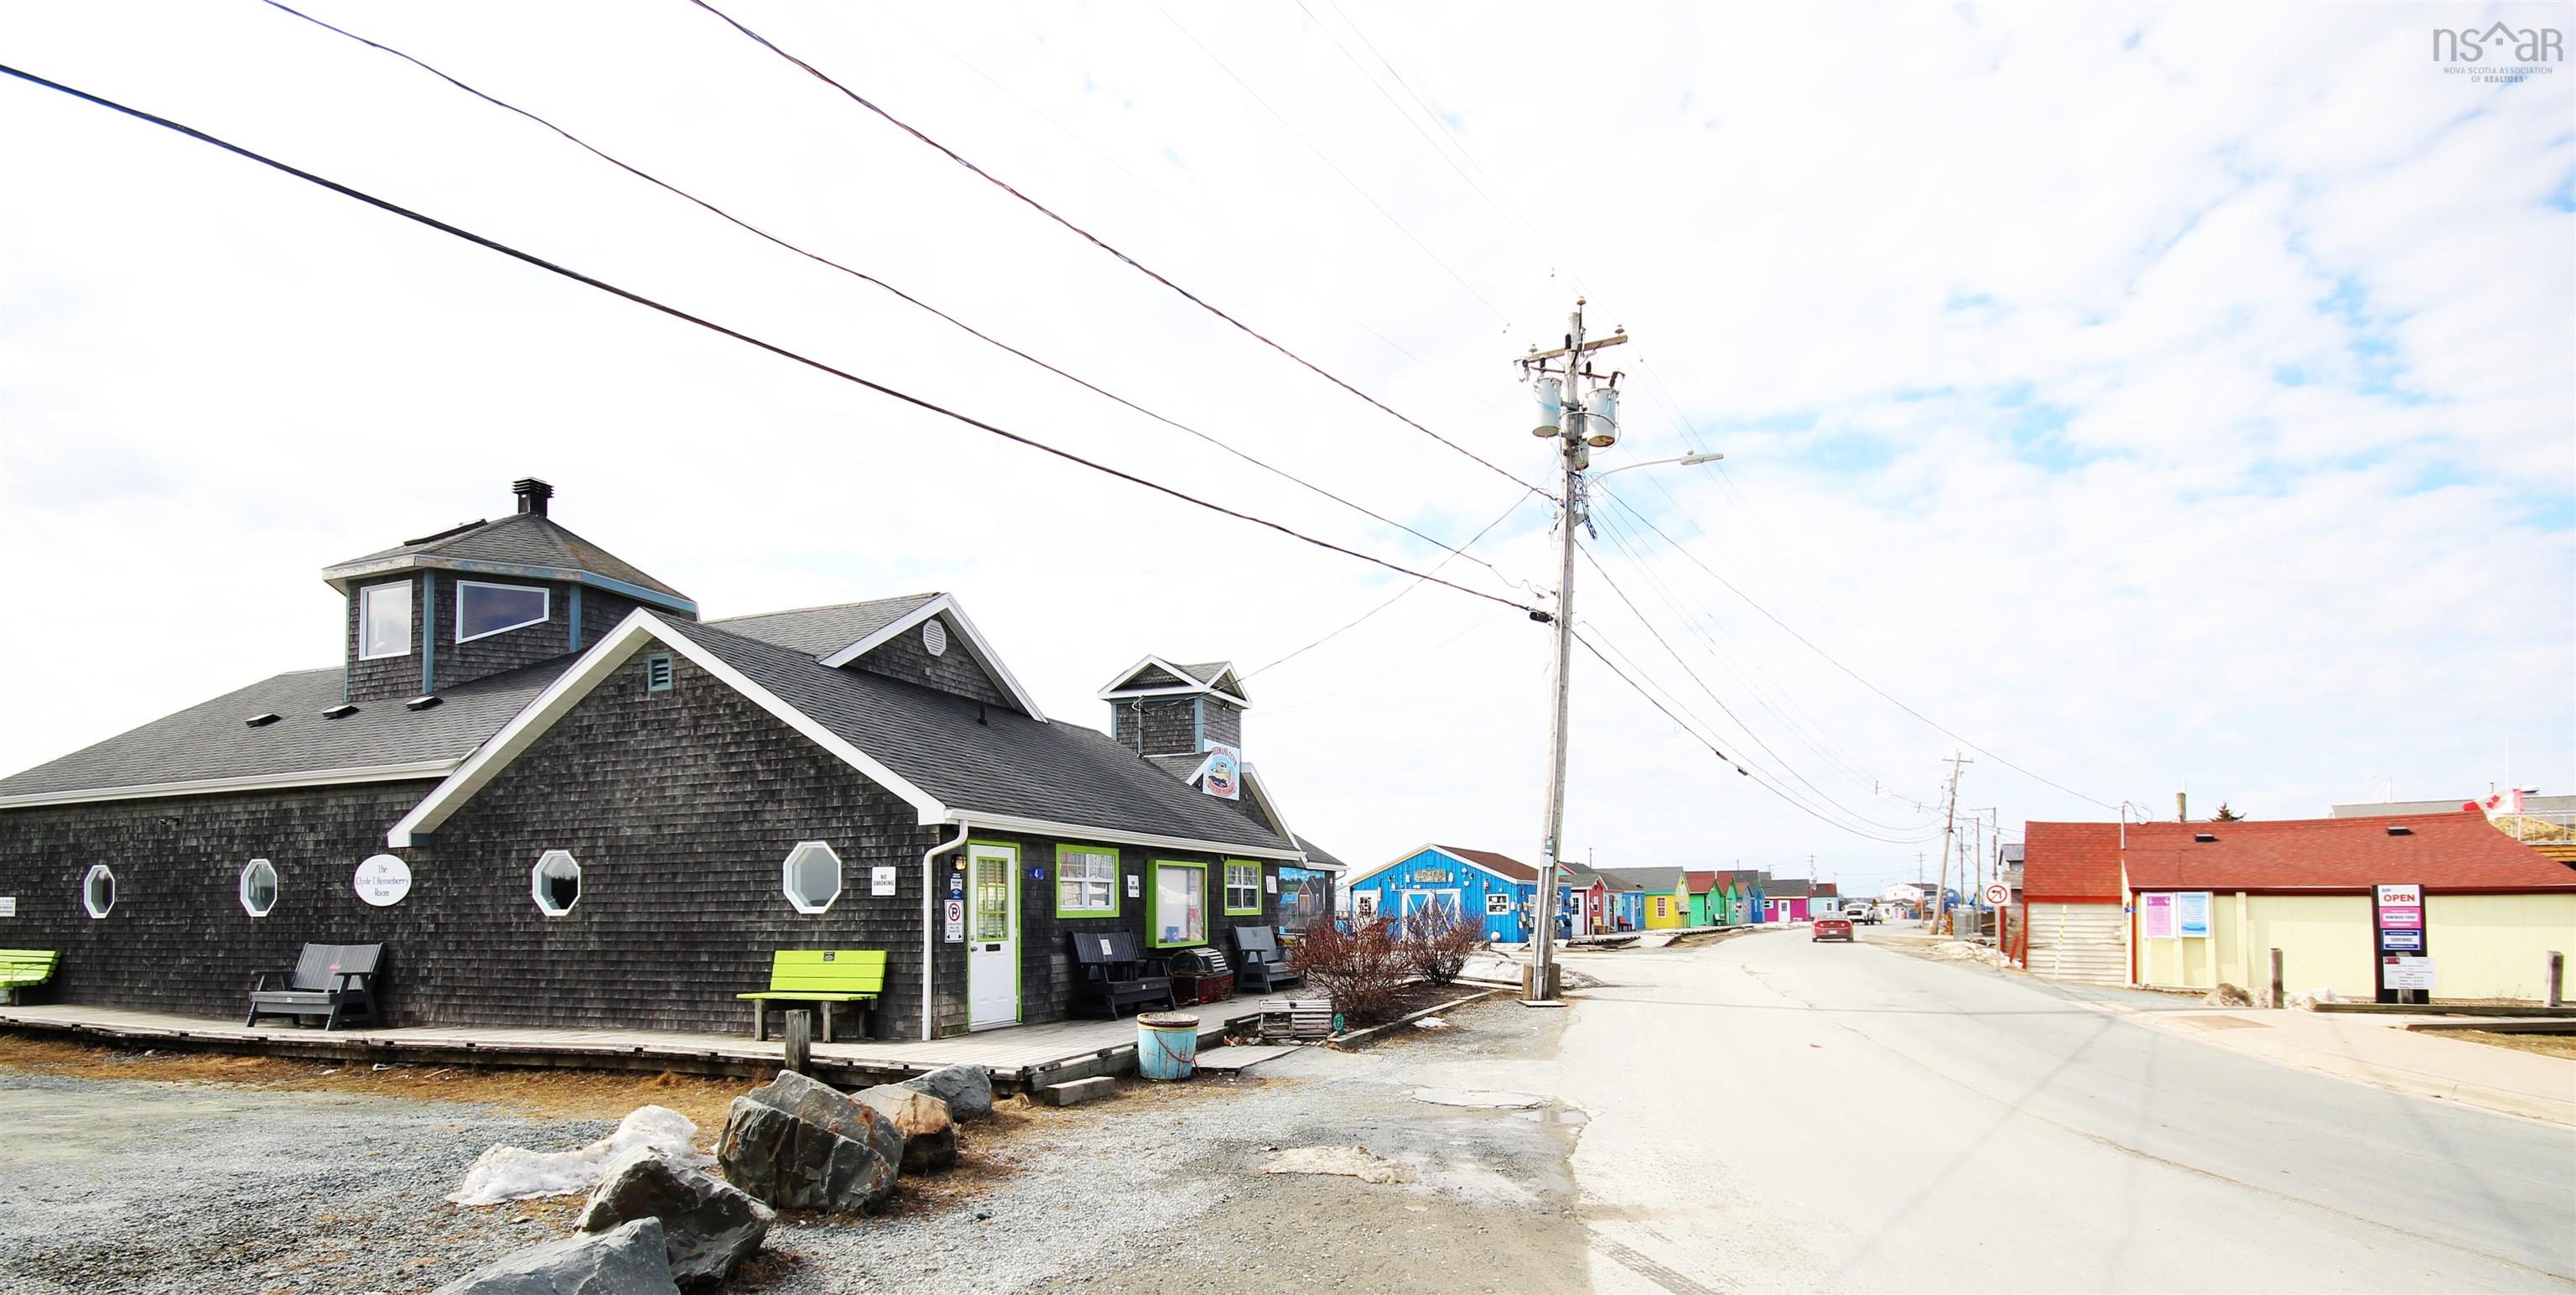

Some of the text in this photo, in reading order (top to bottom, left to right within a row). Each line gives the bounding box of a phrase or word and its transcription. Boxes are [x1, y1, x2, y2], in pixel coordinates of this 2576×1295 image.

[377, 865, 388, 874] The
[1034, 868, 1039, 879] 4
[356, 876, 371, 887] Clyde
[374, 888, 390, 897] Room
[2383, 894, 2415, 902] OPEN
